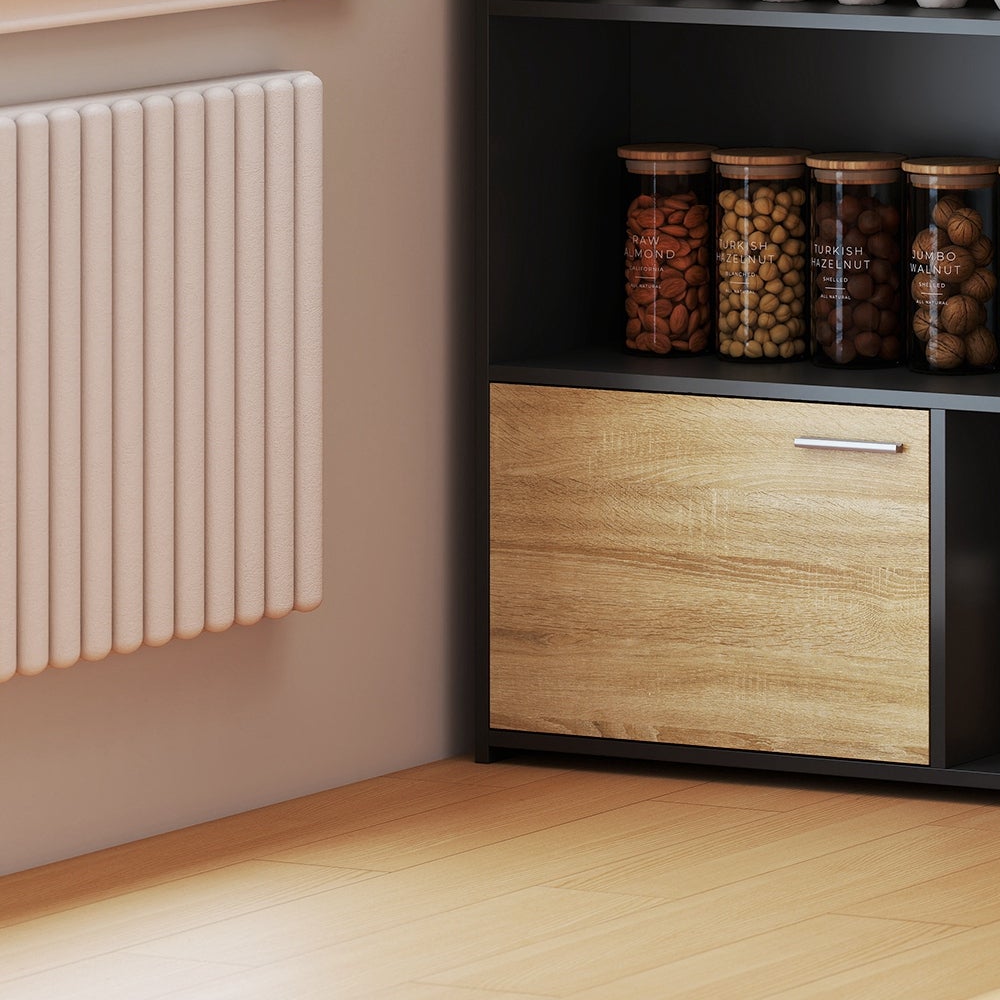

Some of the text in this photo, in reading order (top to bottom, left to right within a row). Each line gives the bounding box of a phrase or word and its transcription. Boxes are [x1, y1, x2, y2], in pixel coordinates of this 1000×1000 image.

[632, 235, 660, 245] RAW
[719, 238, 768, 251] TURKISH
[623, 247, 676, 259] ALMOND
[814, 243, 863, 256] TURKISH
[912, 249, 957, 262] JUMBO
[716, 251, 775, 265] HAZELNUT
[811, 257, 871, 270] HAZELNUT
[910, 262, 961, 275] WALNUT
[918, 281, 946, 289] SHELLED
